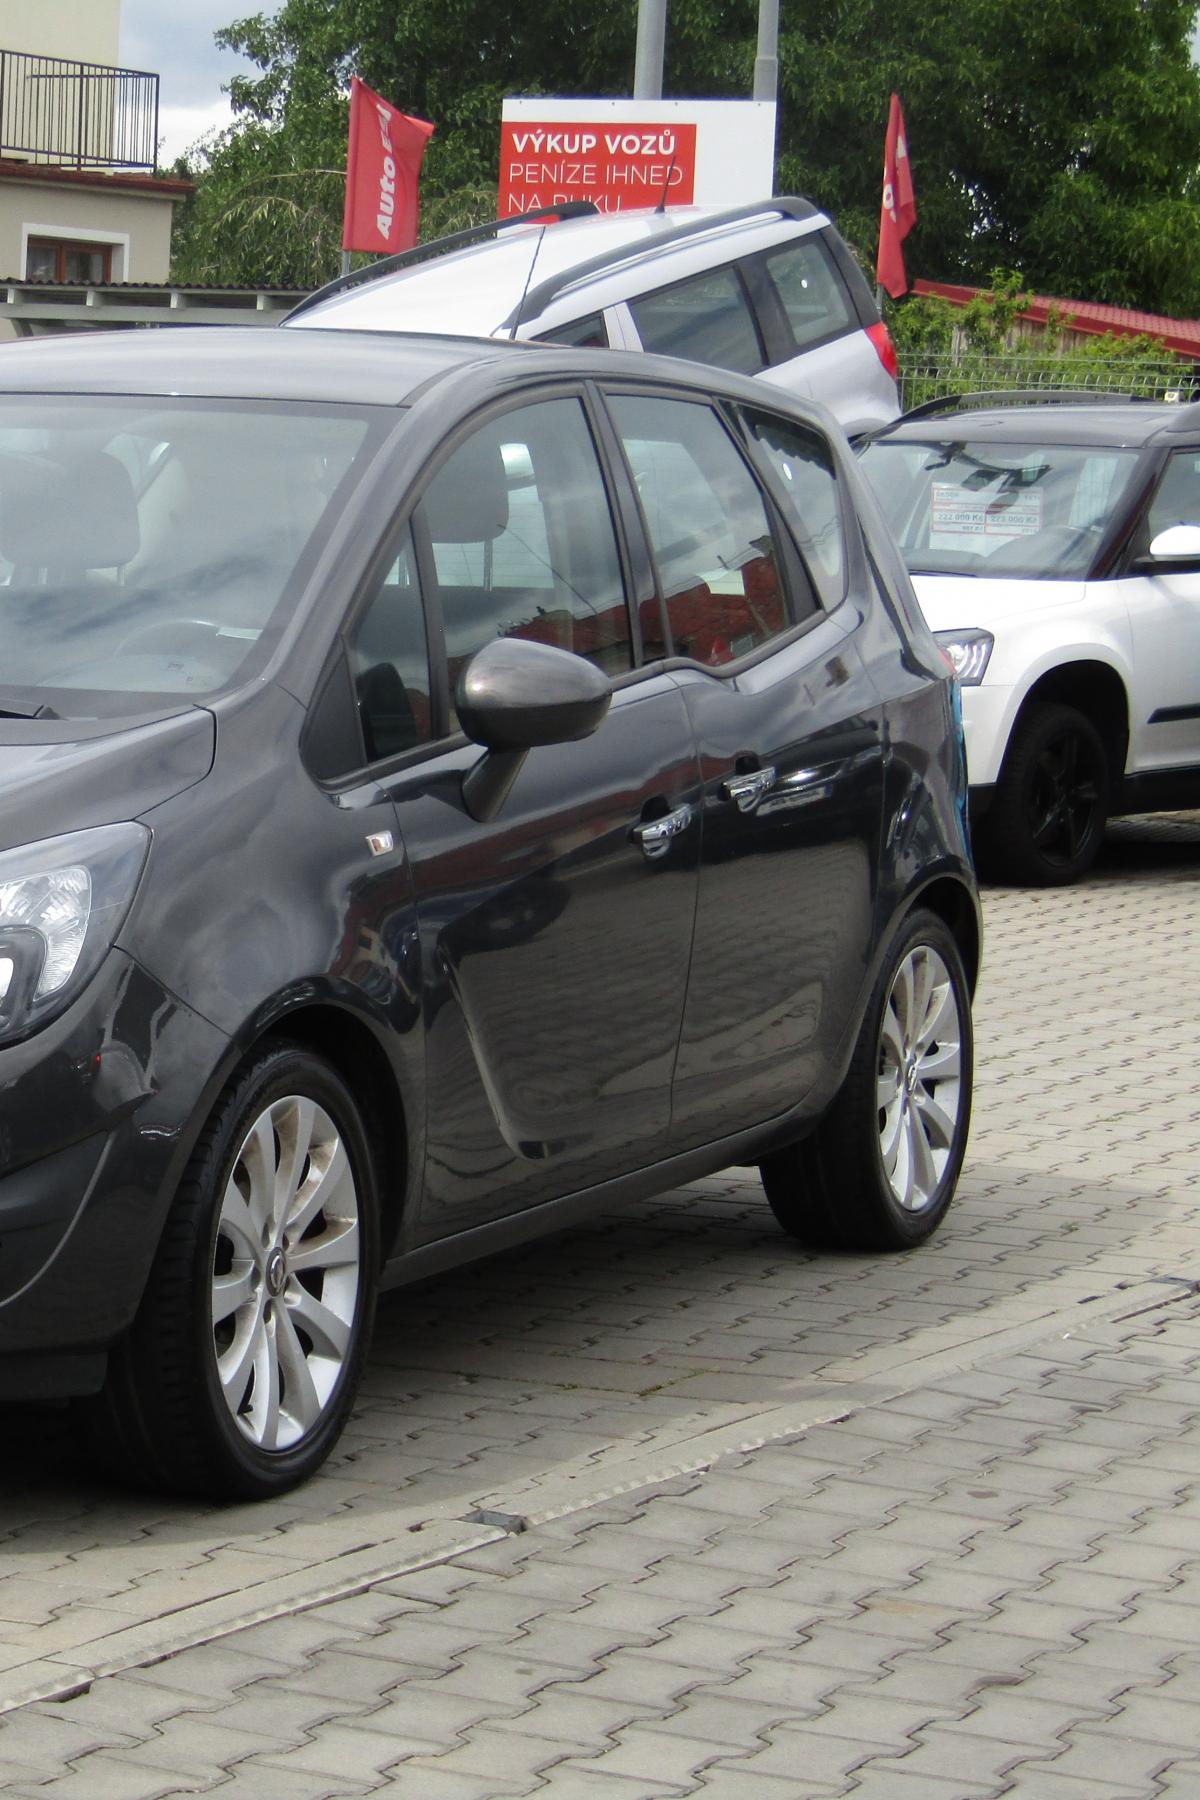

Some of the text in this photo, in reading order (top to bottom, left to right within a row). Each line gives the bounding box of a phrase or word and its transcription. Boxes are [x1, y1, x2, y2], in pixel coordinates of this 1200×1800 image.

[512, 128, 676, 155] VÝKUP VOZŮ
[509, 159, 683, 186] PENÍZE IHNED
[376, 156, 396, 240] Auto
[508, 192, 543, 213] NA
